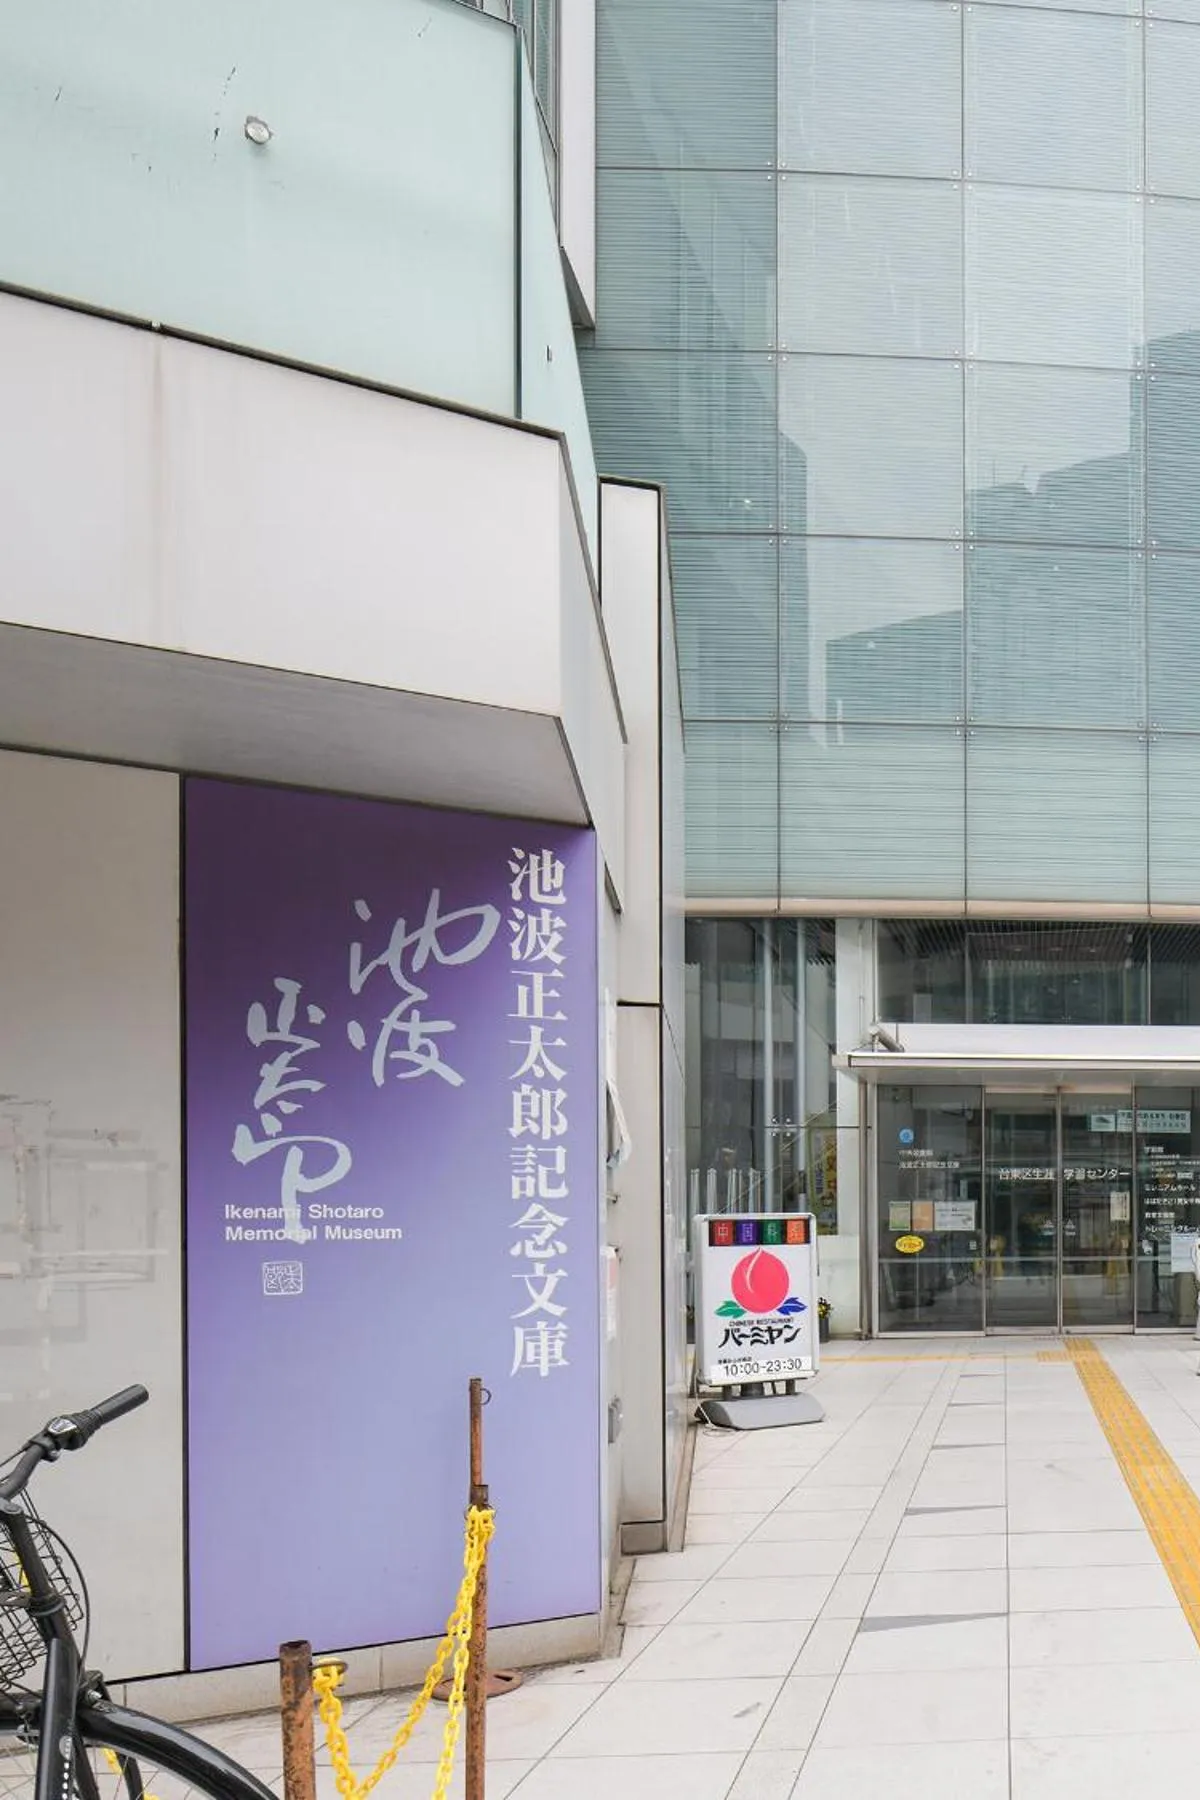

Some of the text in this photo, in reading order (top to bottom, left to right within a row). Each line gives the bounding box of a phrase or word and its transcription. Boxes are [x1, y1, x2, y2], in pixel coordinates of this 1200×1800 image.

[507, 847, 570, 1377] 池波正太郎記念文庫
[308, 1204, 384, 1219] Shotaro
[325, 1225, 403, 1240] Museum
[718, 1325, 802, 1348] バーミヤン
[724, 1358, 802, 1376] 10:00-23:30
